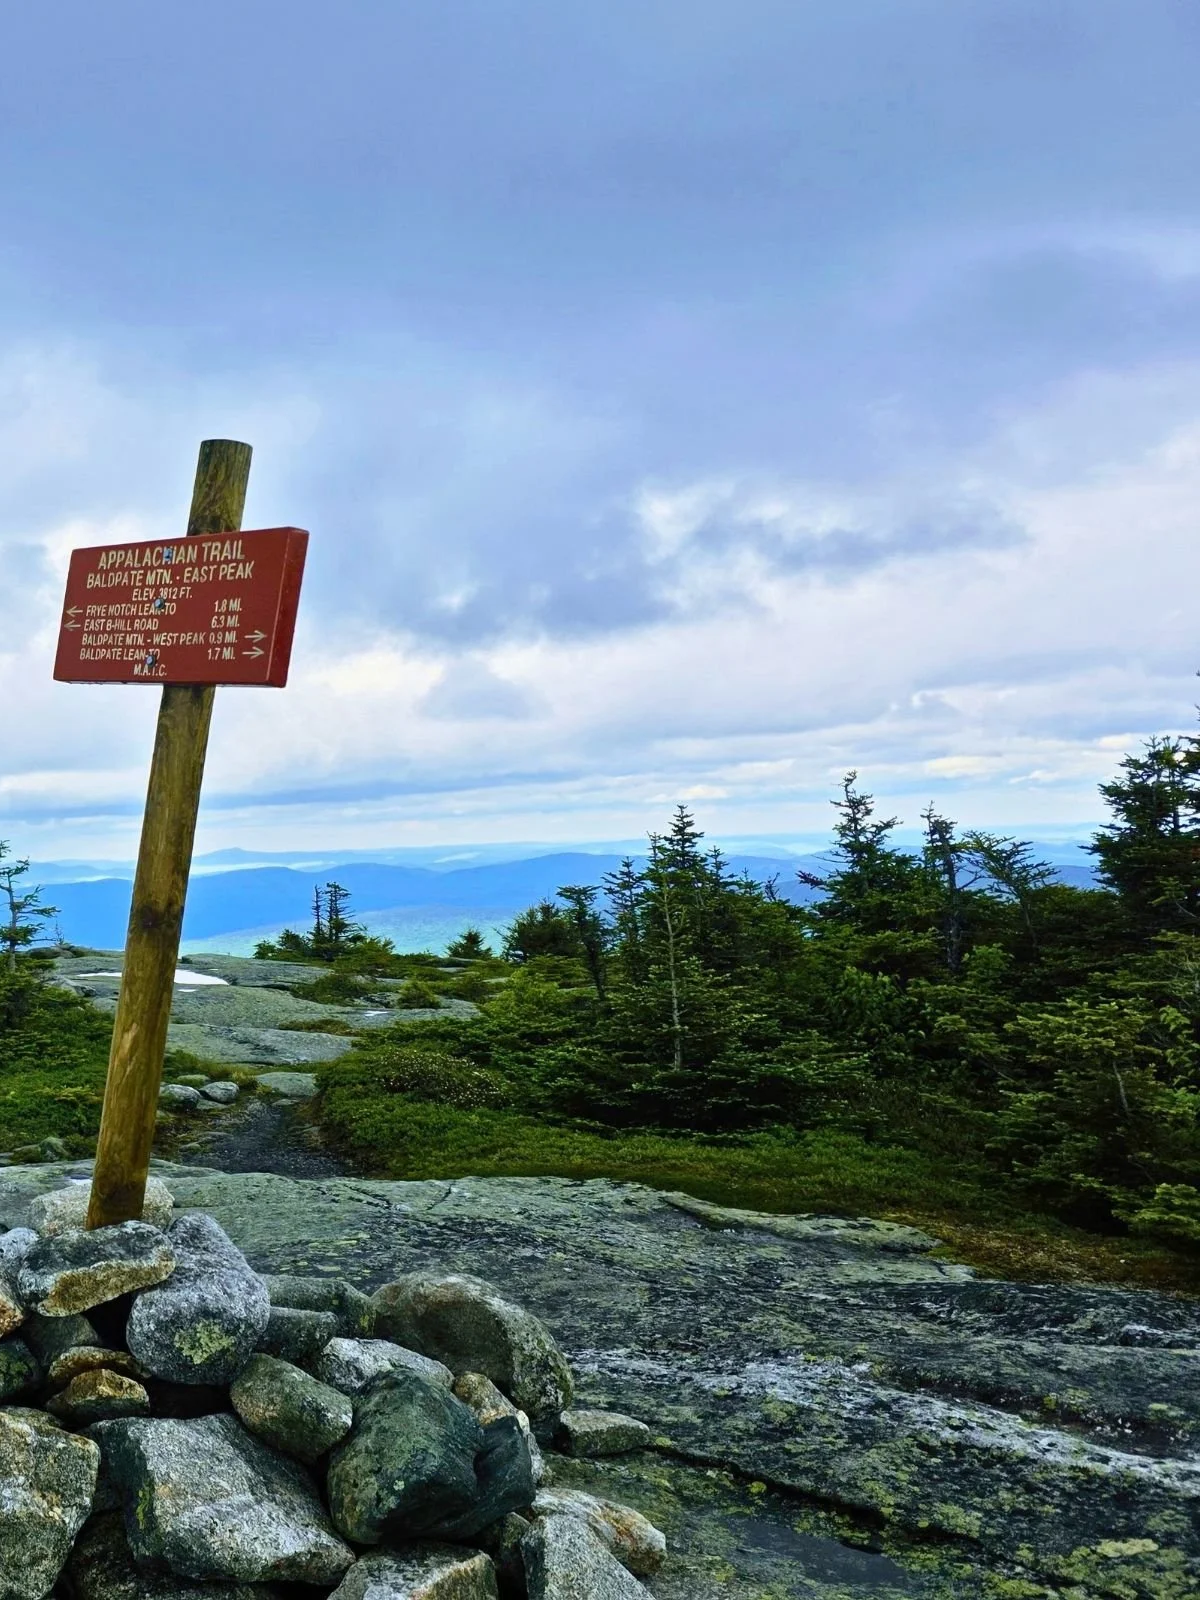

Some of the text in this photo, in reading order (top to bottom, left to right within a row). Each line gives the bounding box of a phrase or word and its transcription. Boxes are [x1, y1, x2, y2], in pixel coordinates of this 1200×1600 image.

[202, 539, 245, 562] TRAIL
[87, 570, 144, 589] BALDPATE
[146, 568, 173, 585] MTN.
[183, 564, 218, 584] EAST
[219, 560, 255, 581] PEAK
[132, 587, 156, 601] ELEV.
[179, 586, 193, 599] FT.
[86, 604, 107, 617] FRYE
[108, 603, 137, 616] NOTCH
[214, 599, 228, 613] 1.8
[229, 597, 242, 612] MI.
[83, 614, 240, 631] EAST B-HILL ROAD 6.3 MI.
[81, 633, 125, 647] BALDPATE
[125, 633, 145, 646] MTN.
[153, 632, 179, 647] WEST
[180, 631, 206, 646] PEAK
[208, 631, 223, 645] 0.9
[224, 630, 238, 644] MI.
[79, 648, 123, 661] BALDPATE
[207, 647, 221, 661] 1.7
[221, 646, 236, 661] MI.
